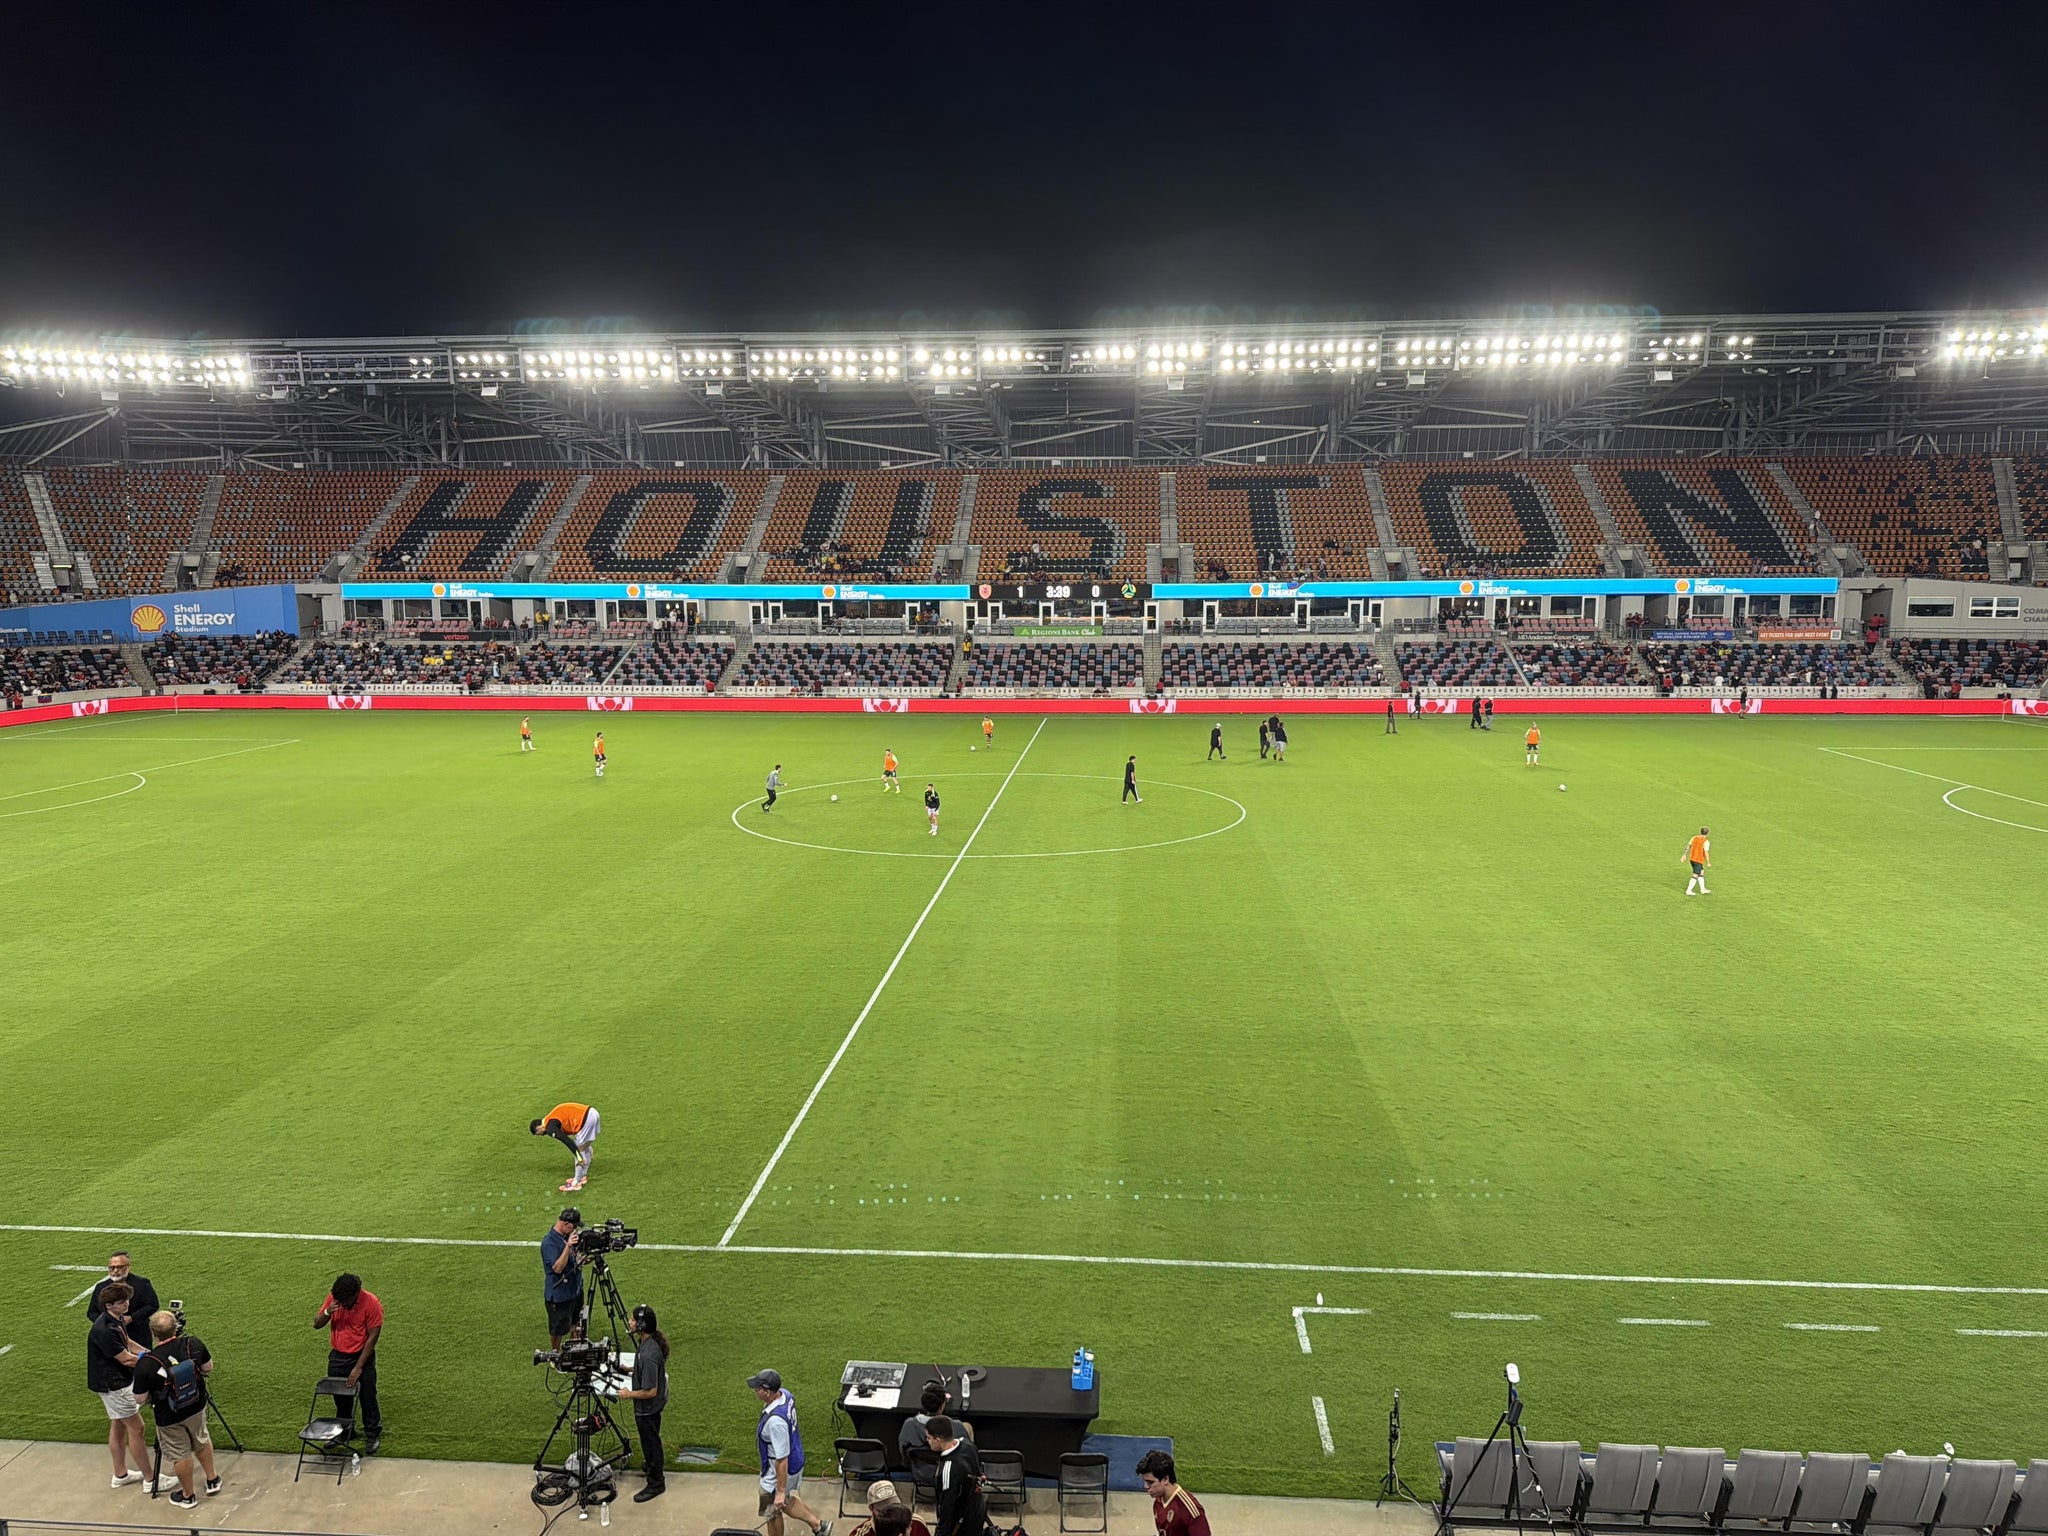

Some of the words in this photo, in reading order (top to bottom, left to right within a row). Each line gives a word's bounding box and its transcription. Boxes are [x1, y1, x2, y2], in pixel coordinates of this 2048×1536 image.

[385, 469, 1799, 572] HOUSTON
[1017, 585, 1024, 598] 1
[1046, 585, 1071, 598] 3:39
[1091, 585, 1100, 598] 0
[1694, 585, 1725, 593] ENERGY
[173, 603, 200, 613] Shell
[174, 613, 235, 626] ENERGY
[1081, 628, 1096, 636] Club
